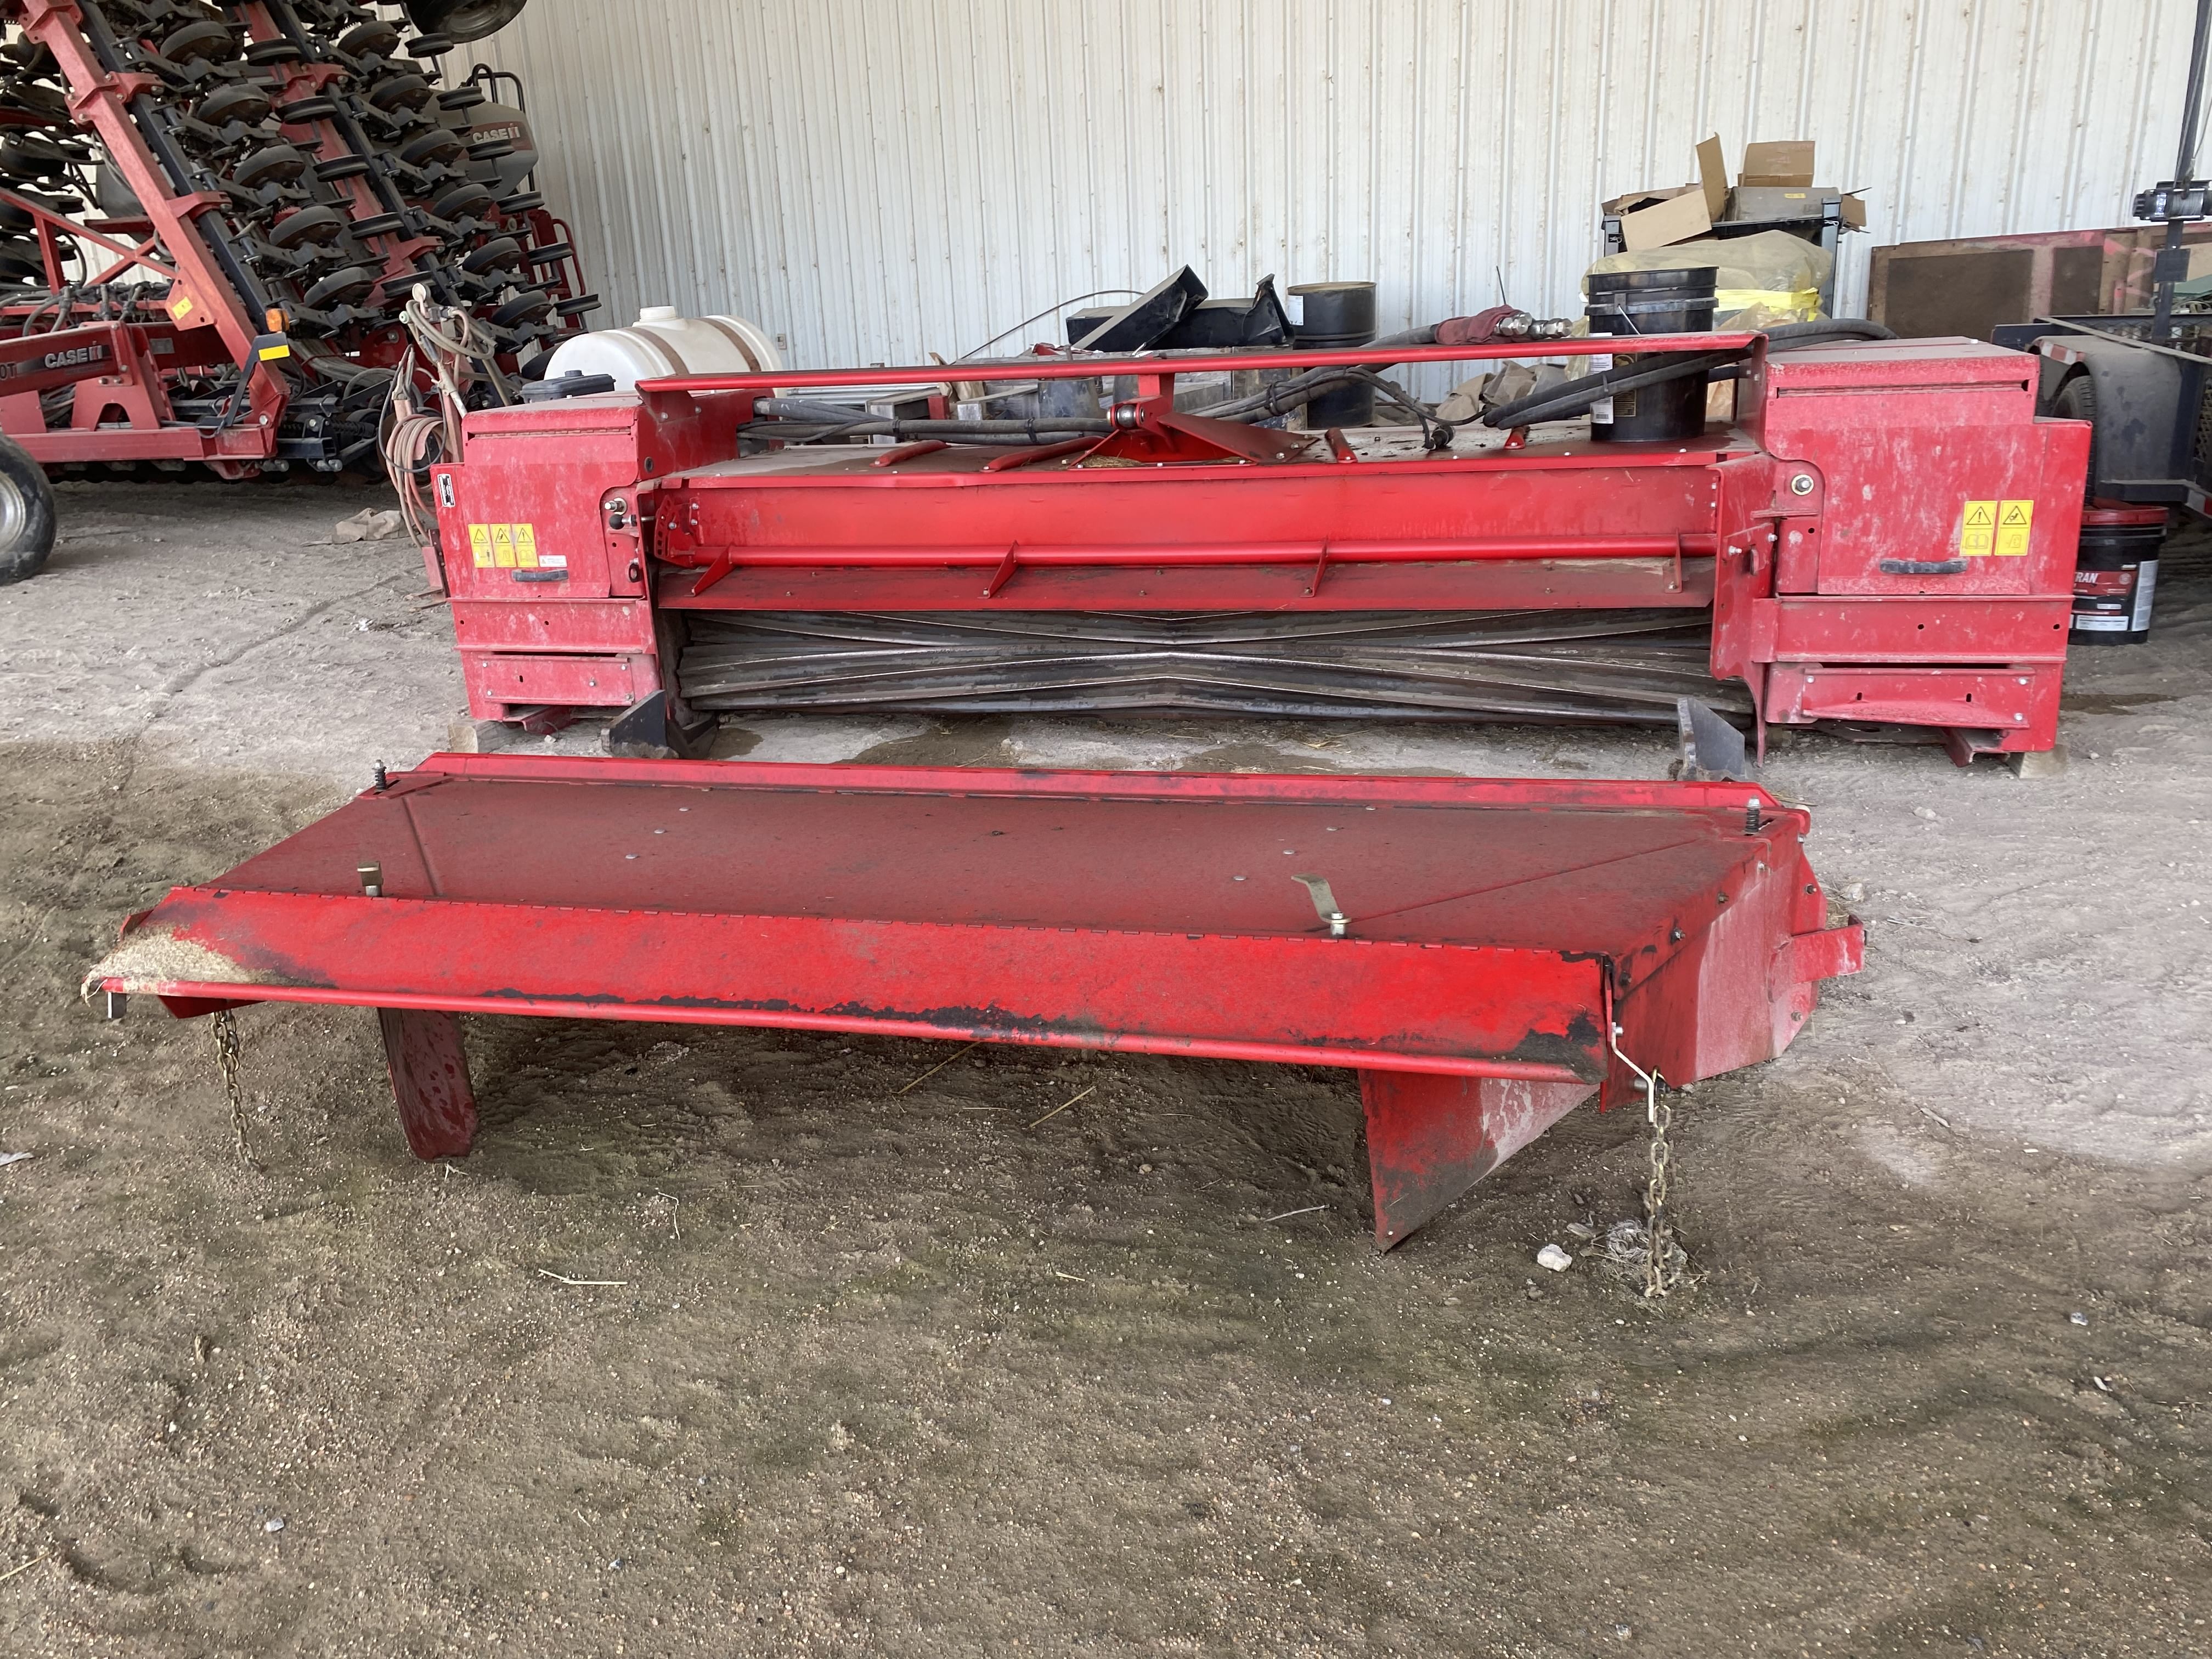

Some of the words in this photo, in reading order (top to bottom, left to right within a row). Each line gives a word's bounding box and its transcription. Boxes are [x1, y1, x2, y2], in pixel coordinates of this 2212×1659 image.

[472, 128, 509, 144] CASE
[44, 347, 88, 369] CASE
[2074, 572, 2098, 584] RAN
